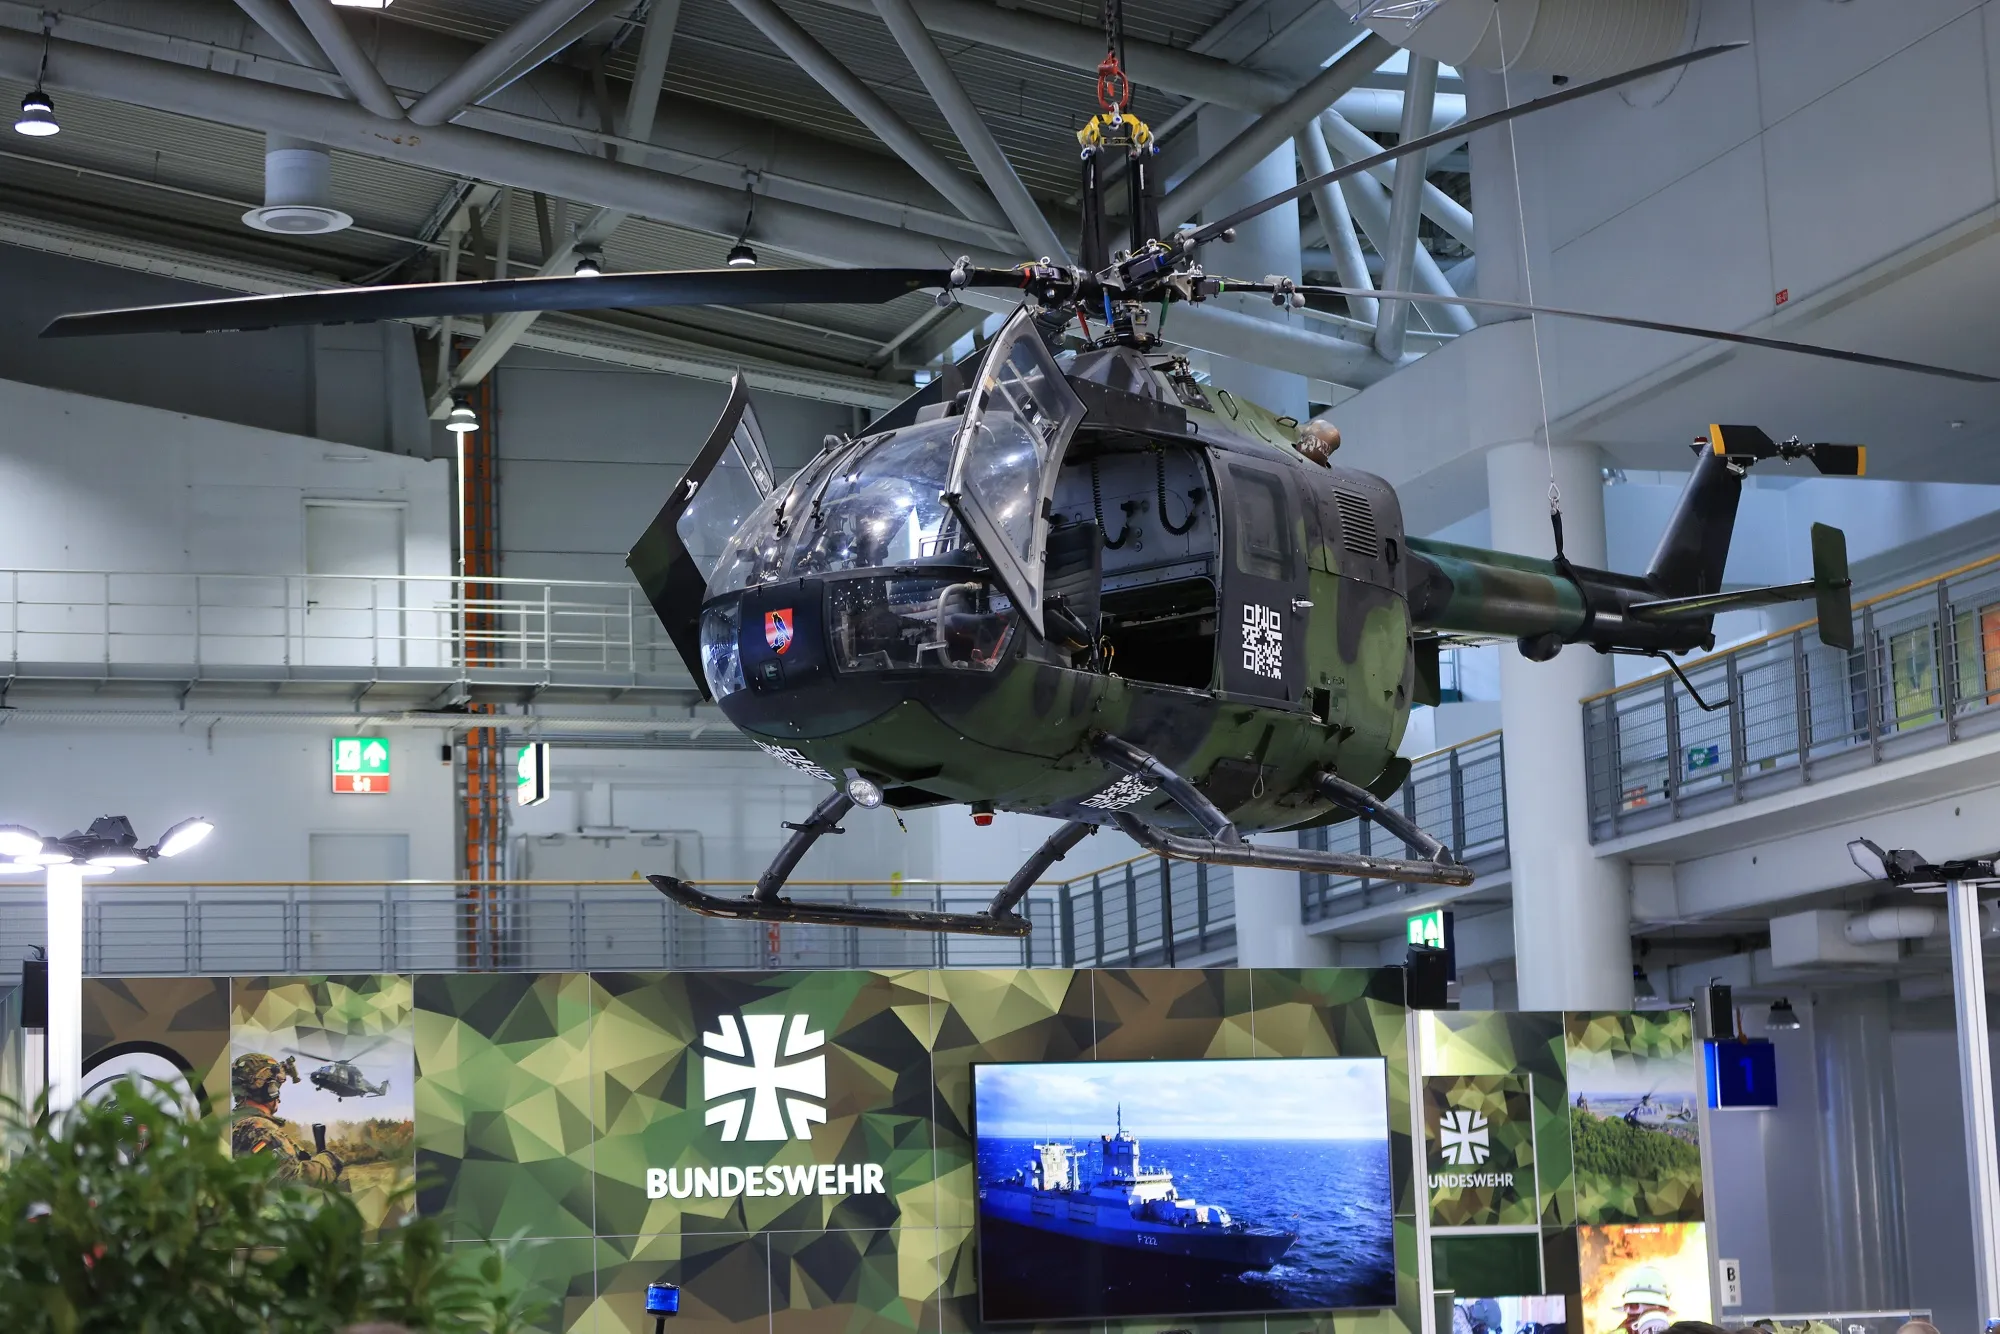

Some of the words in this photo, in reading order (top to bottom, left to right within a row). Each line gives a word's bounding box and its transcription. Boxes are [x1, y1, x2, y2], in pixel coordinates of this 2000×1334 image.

[1740, 1057, 1753, 1093] 1
[646, 1163, 886, 1199] BUNDESWEHR
[1428, 1173, 1514, 1188] UNDESWEHR
[1137, 1234, 1142, 1243] F
[1143, 1236, 1158, 1246] 222
[1727, 1267, 1736, 1281] B
